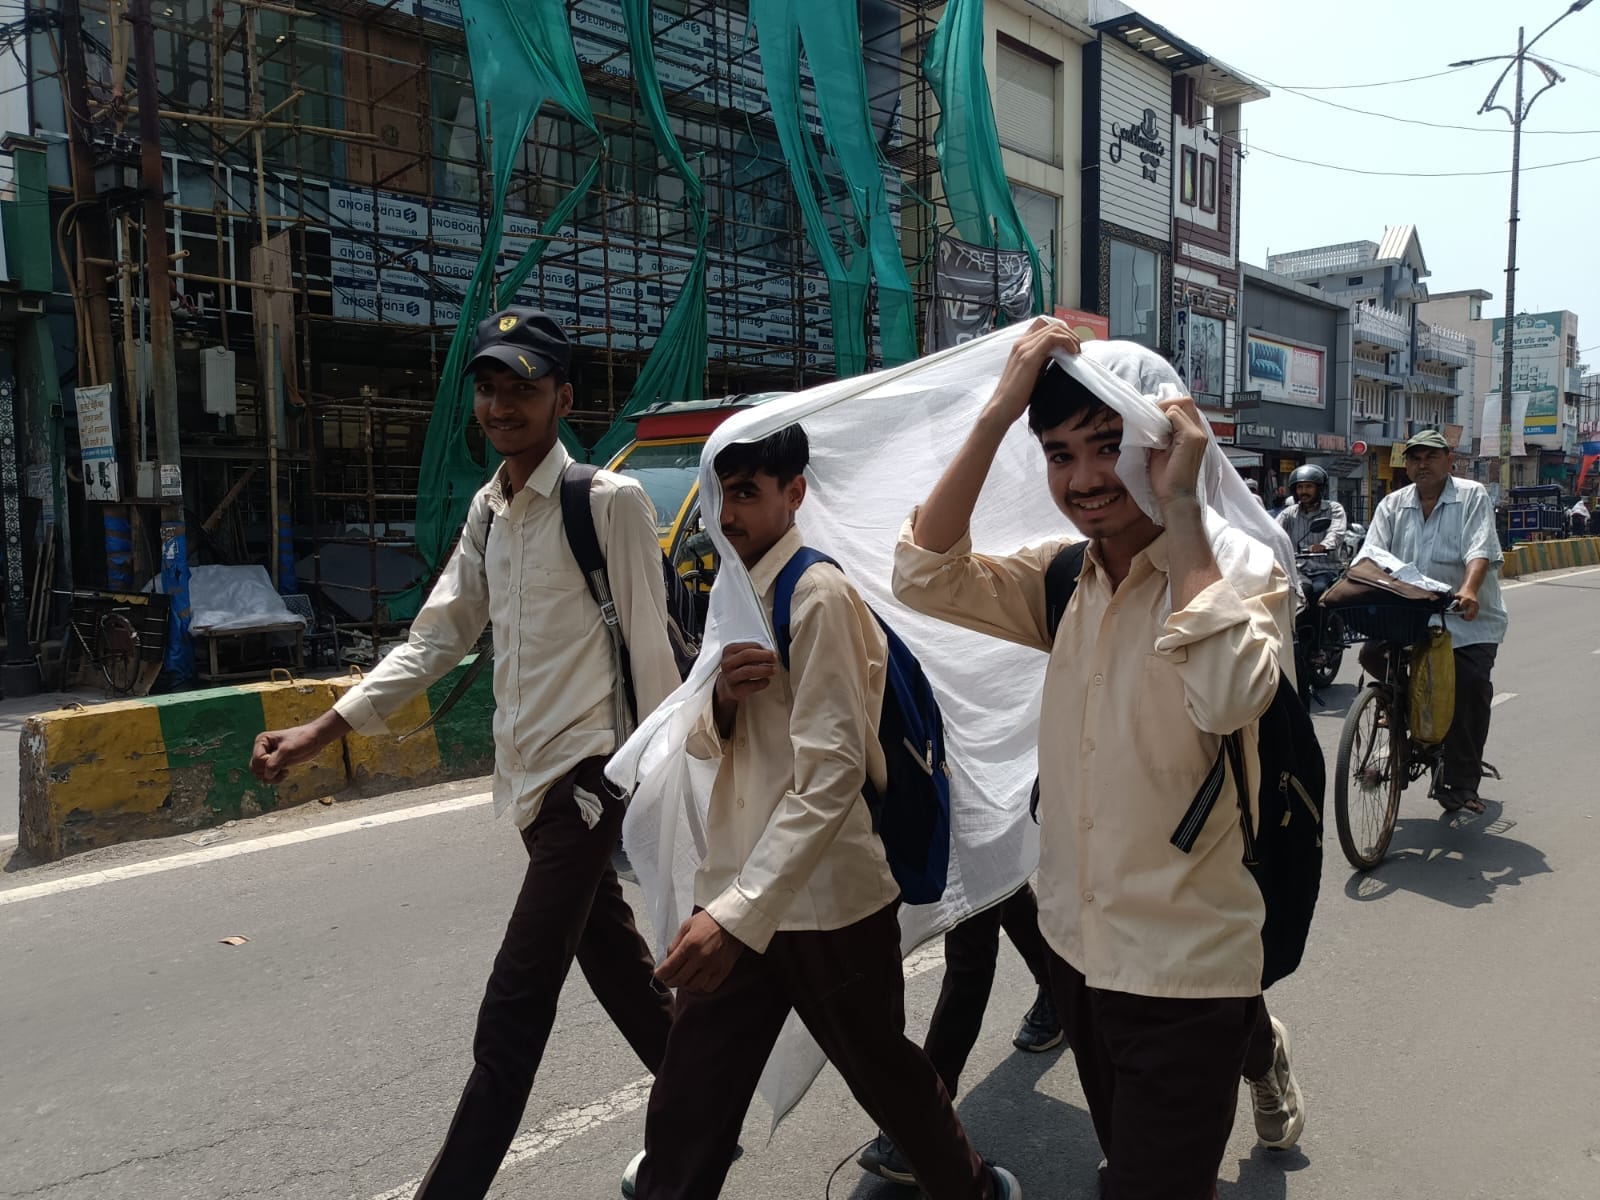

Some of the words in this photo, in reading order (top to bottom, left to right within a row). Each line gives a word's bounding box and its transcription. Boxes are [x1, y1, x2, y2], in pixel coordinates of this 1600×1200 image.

[589, 17, 625, 34] EUROBO
[338, 199, 401, 218] EURBOND
[431, 217, 480, 234] UROBOND
